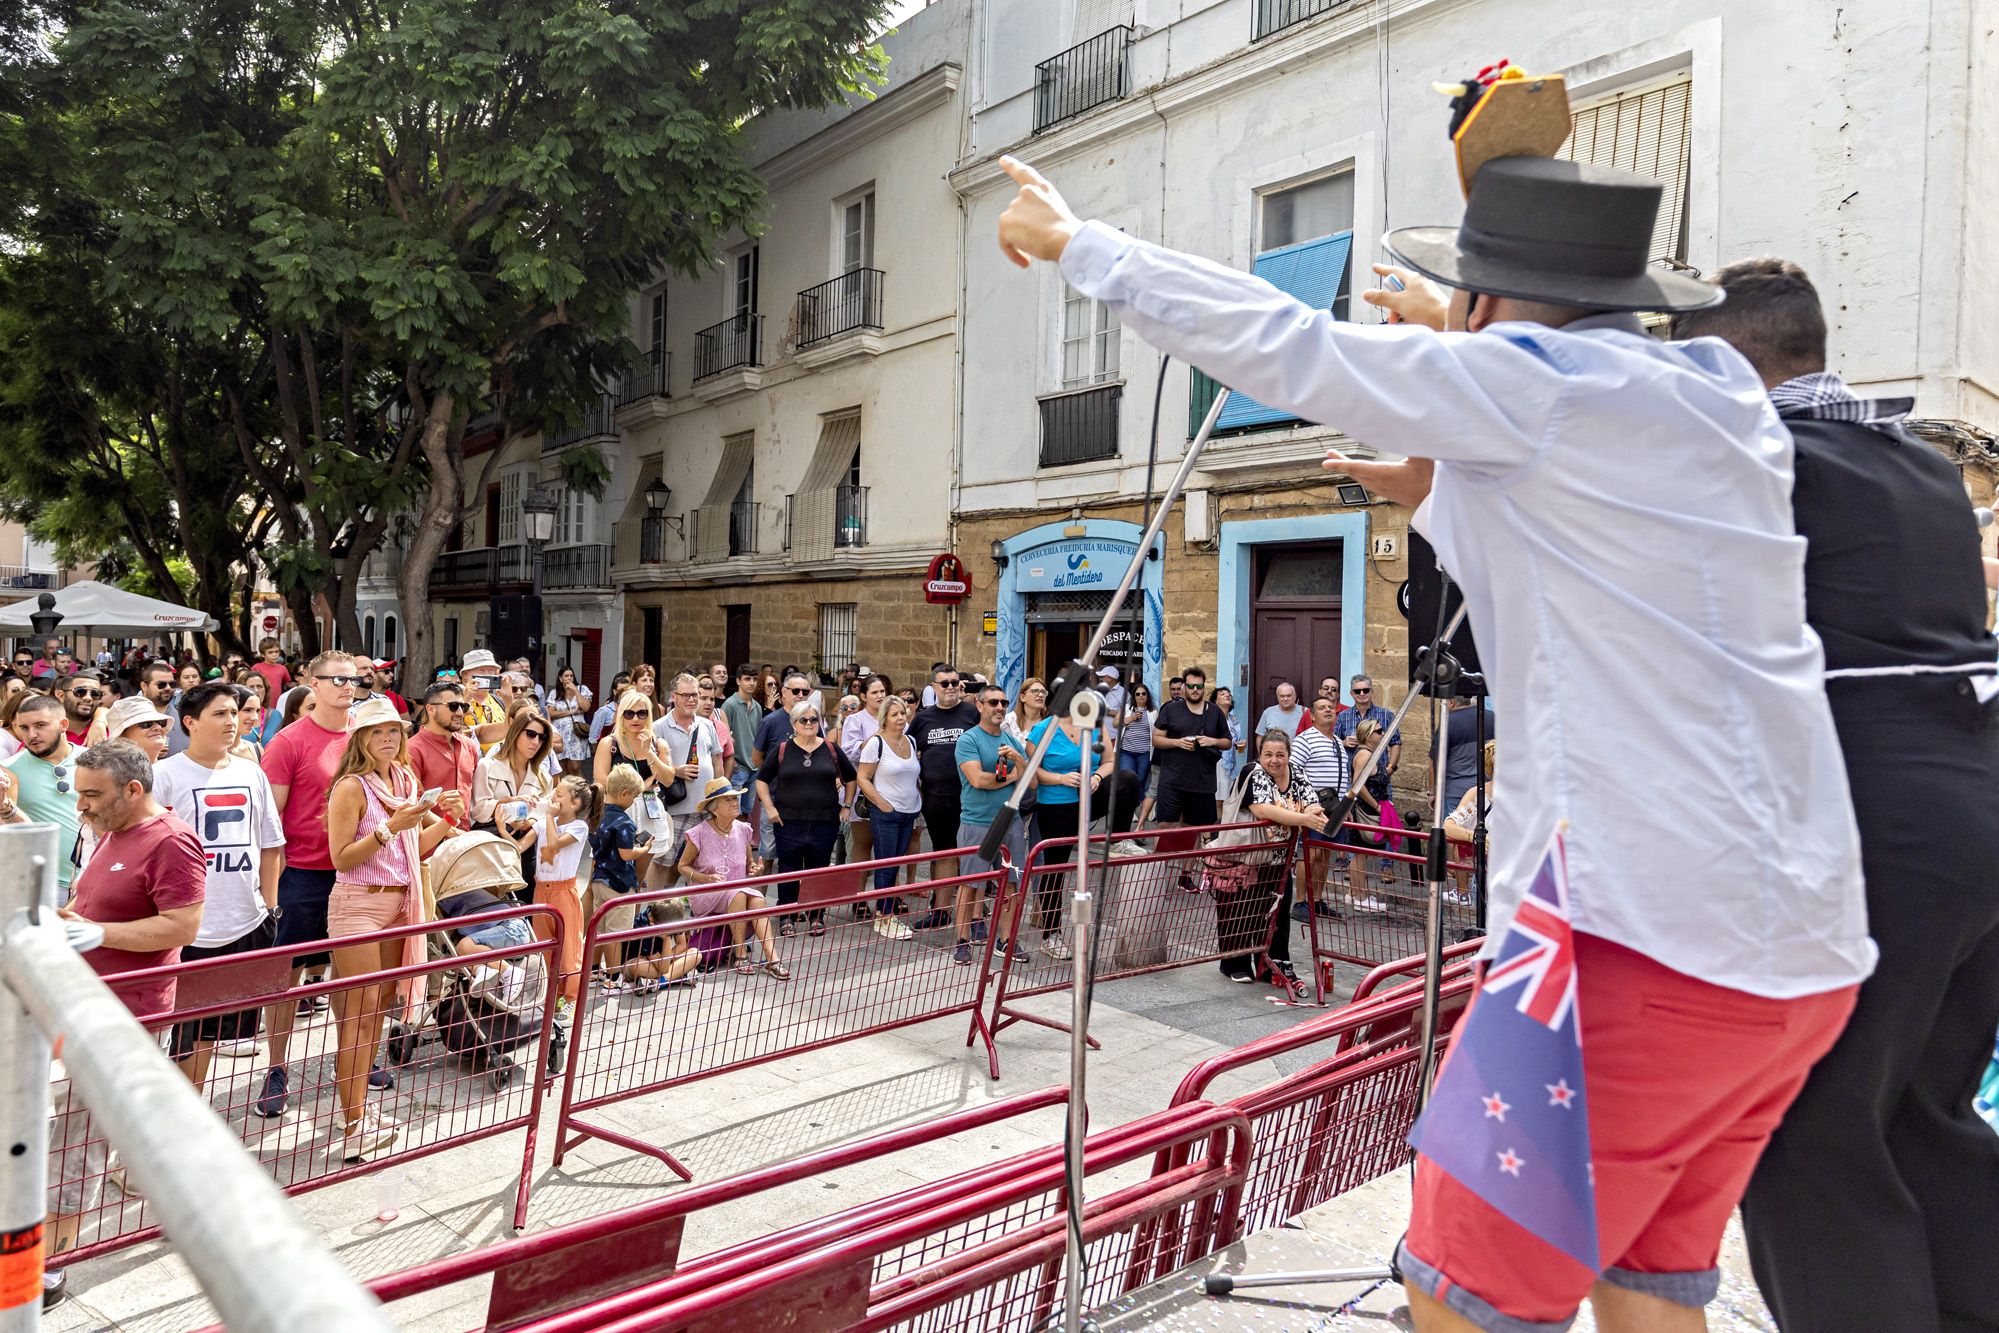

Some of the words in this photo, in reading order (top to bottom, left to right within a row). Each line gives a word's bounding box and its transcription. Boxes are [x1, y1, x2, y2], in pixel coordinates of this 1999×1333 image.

[1096, 543, 1137, 556] MARISQUER
[1374, 539, 1393, 554] 15
[1053, 574, 1065, 588] del
[1066, 570, 1103, 586] Mentidero
[930, 582, 963, 592] Cruzcampo
[154, 613, 196, 623] Cruzcampo
[1100, 631, 1145, 648] DESPACH
[928, 729, 963, 738] ANTI-SOCIAL
[205, 851, 253, 873] FILA
